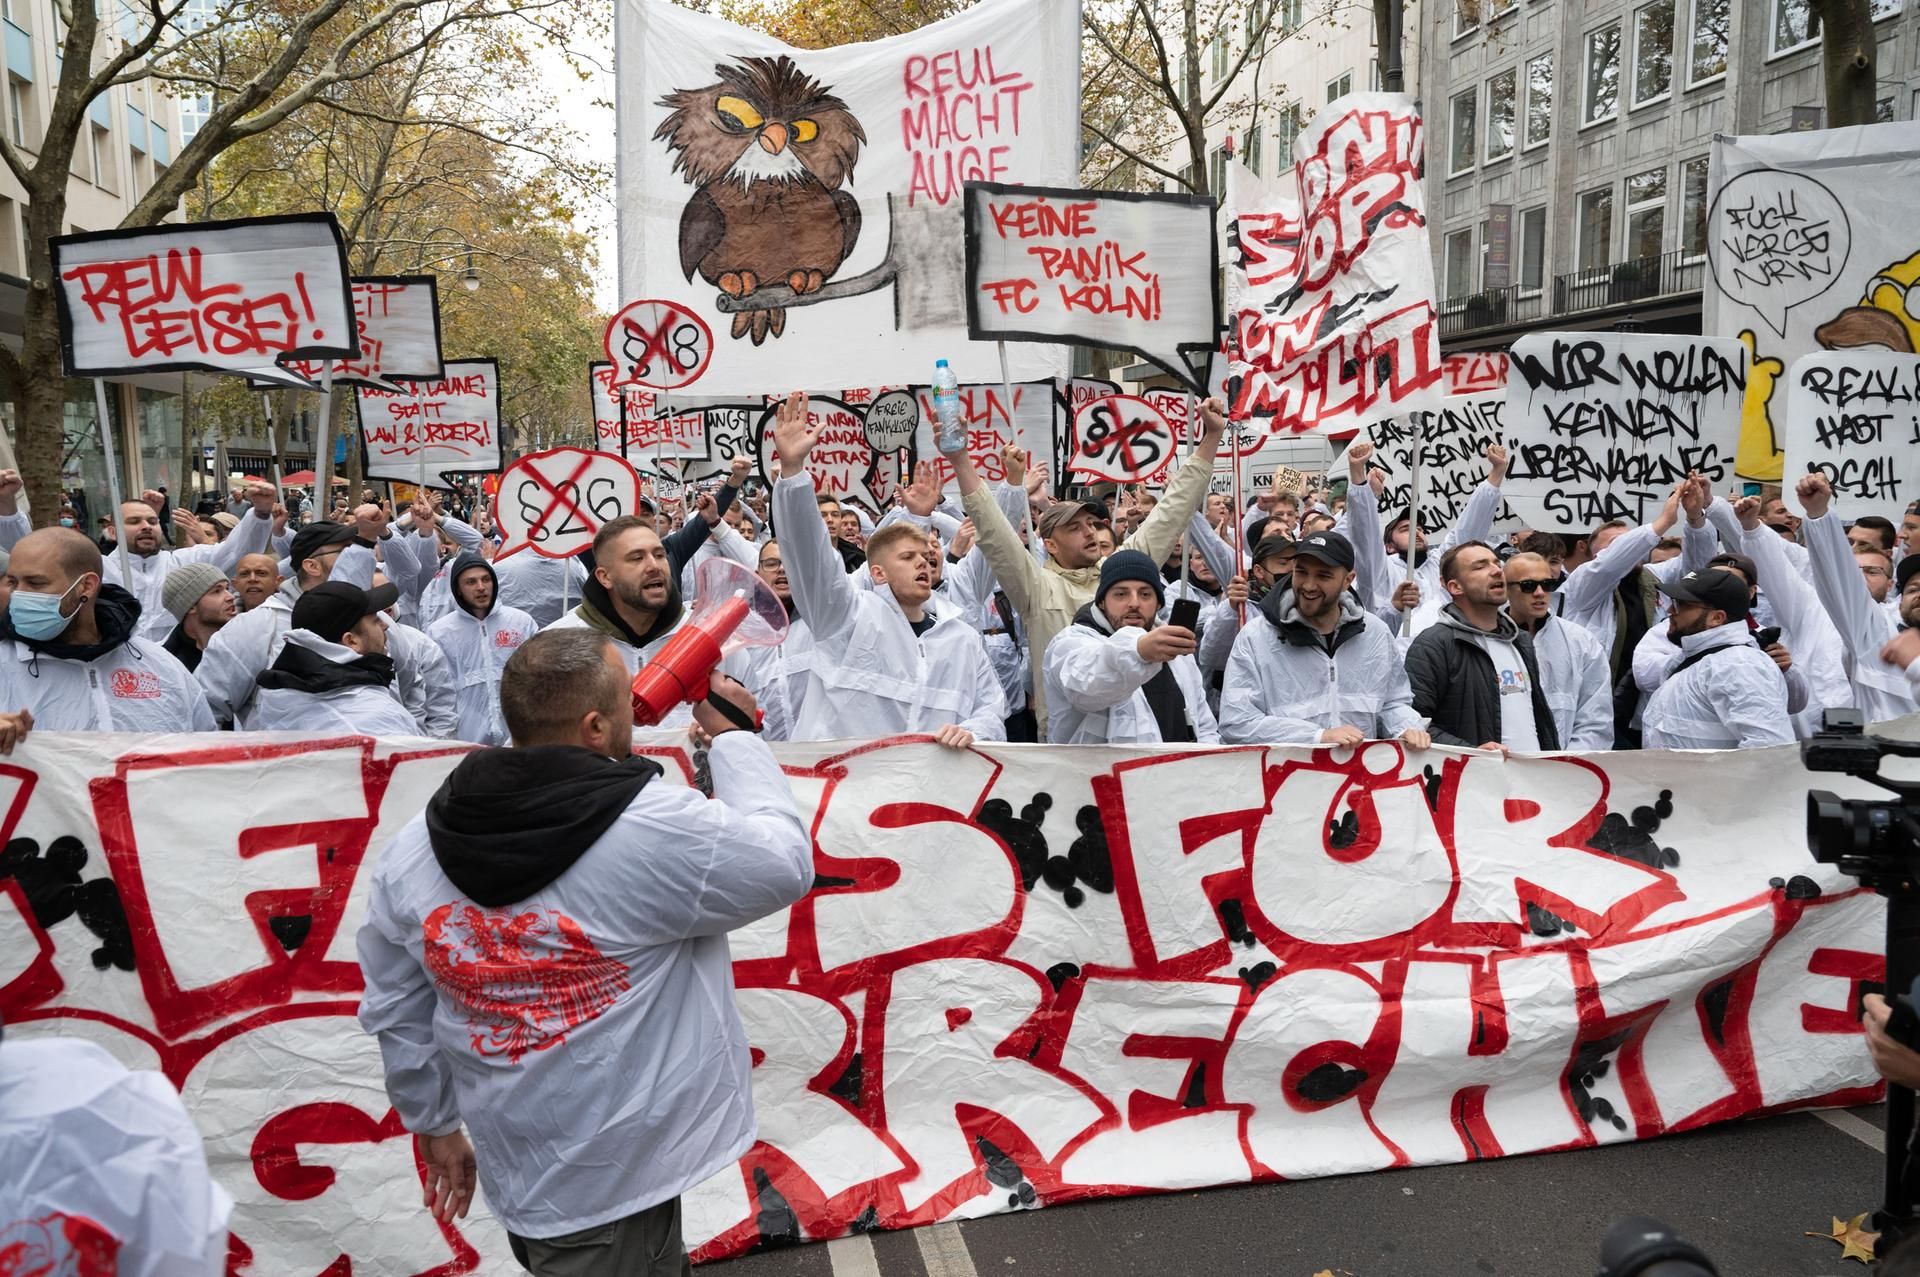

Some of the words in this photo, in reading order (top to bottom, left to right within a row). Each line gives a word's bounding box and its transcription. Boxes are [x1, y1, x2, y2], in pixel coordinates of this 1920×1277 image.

[903, 46, 1024, 99] REUL
[901, 81, 1034, 151] MACHT
[909, 145, 1024, 207] AUGE
[1726, 190, 1806, 231] FUCK
[1733, 256, 1832, 289] NRW
[120, 272, 324, 358] LEISE!
[981, 278, 1039, 315] FC
[1443, 352, 1509, 386] FÜR
[1510, 339, 1621, 392] WIR
[1619, 344, 1747, 394] WOLLEN
[365, 424, 397, 444] LAW
[418, 420, 491, 447] ORDER!
[1815, 413, 1894, 449] HABT
[810, 450, 871, 467] ULTRAS
[1807, 456, 1902, 502] RSCH
[517, 477, 622, 543] §26
[1543, 488, 1658, 527] STAAT
[1092, 735, 1687, 985] FÜR
